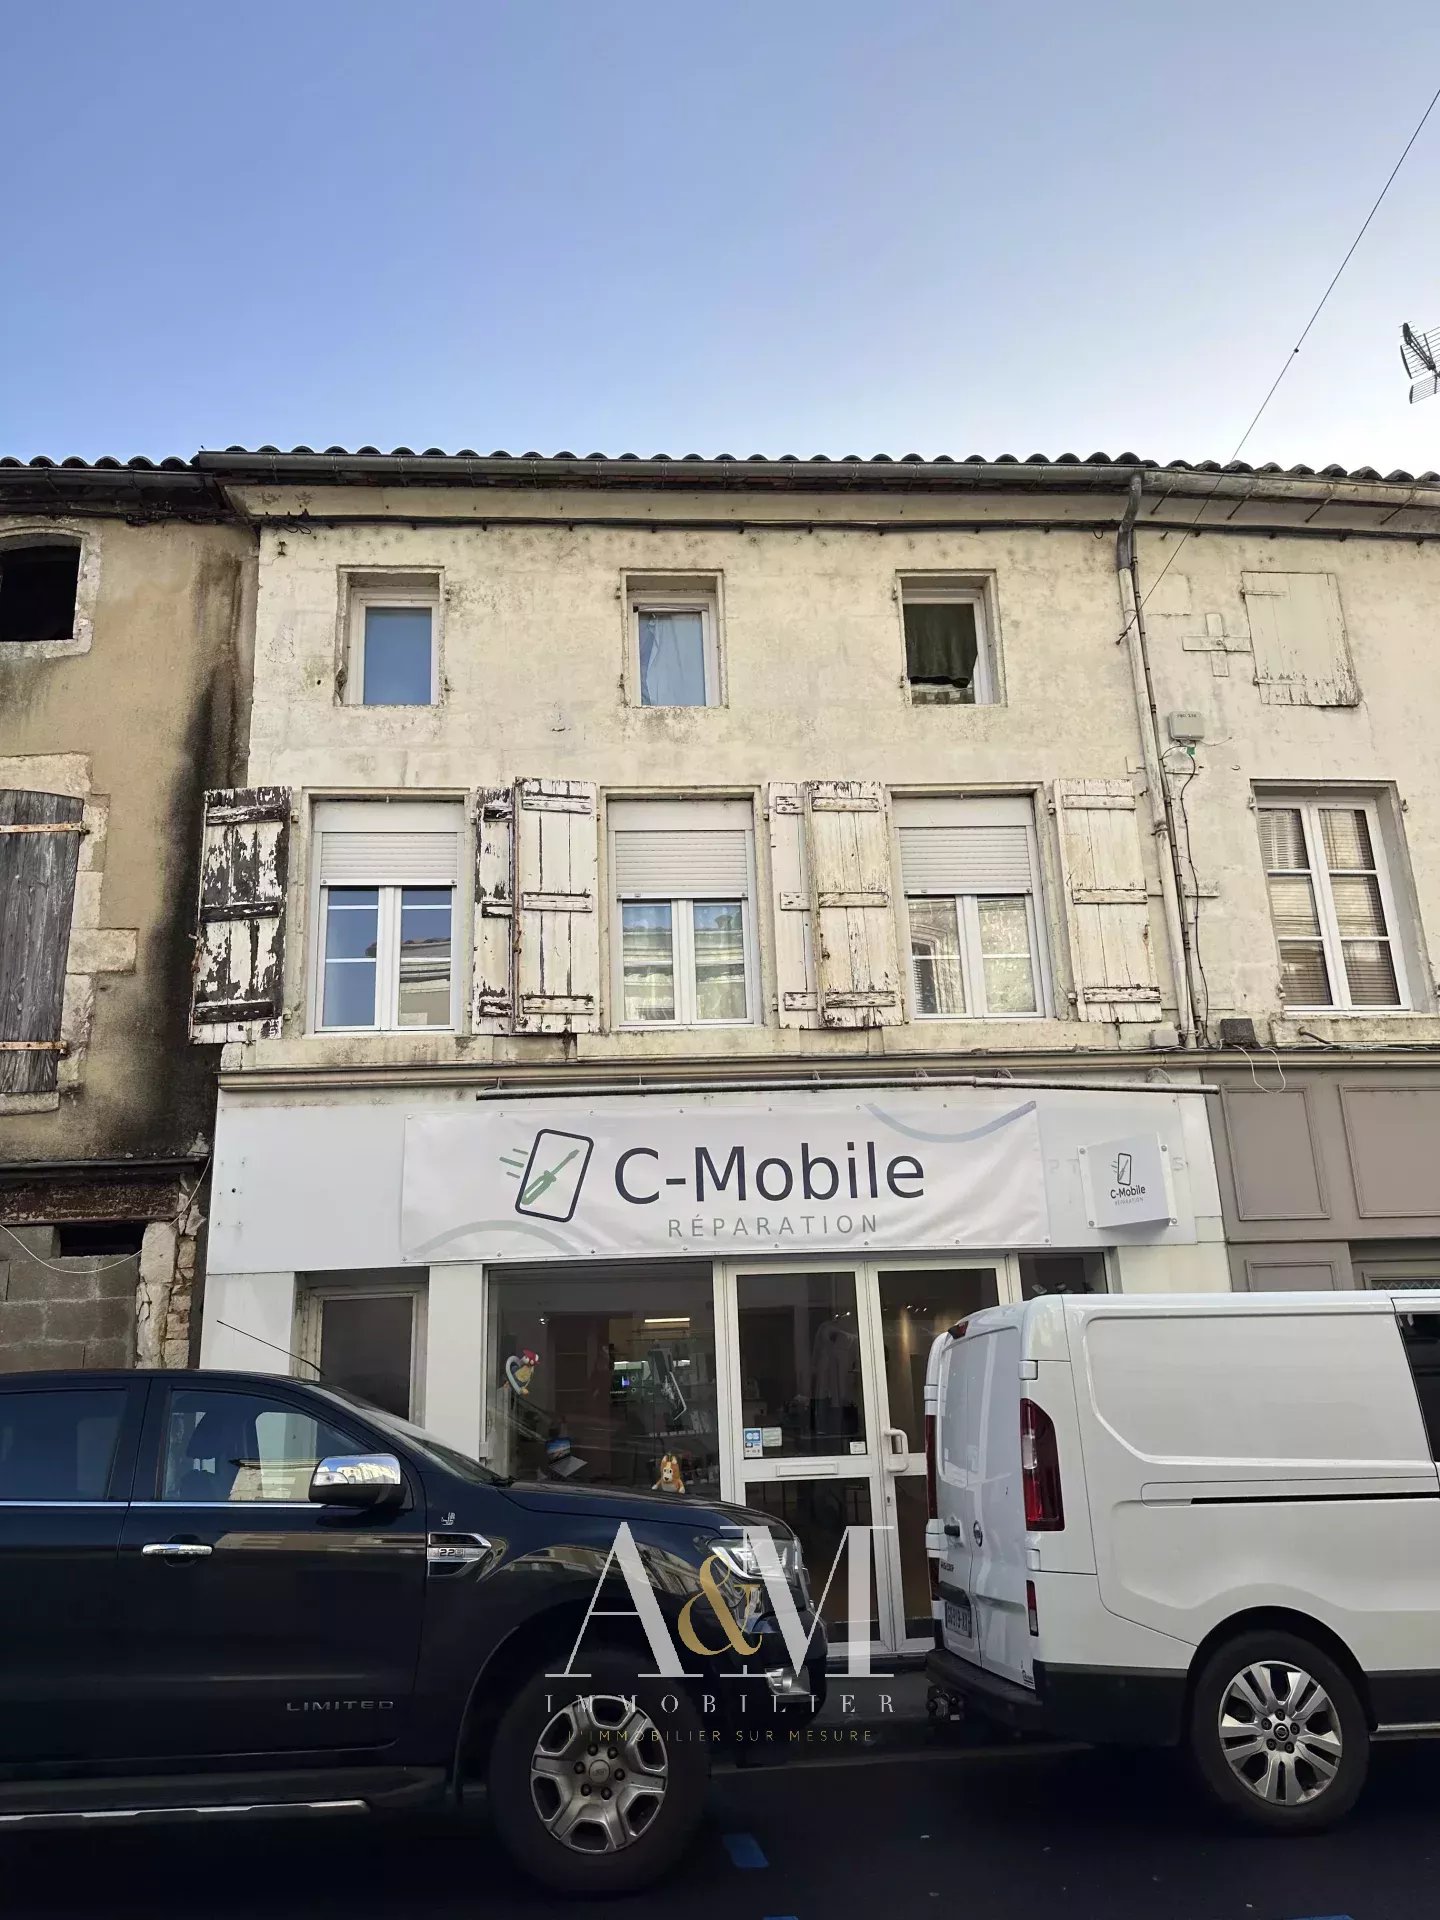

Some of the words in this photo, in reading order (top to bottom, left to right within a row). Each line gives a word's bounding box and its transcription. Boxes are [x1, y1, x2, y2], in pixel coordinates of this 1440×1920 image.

[614, 1141, 925, 1204] C-Mobile
[1110, 1184, 1146, 1199] C-Mobile
[667, 1214, 878, 1238] RÉPARATION
[286, 1701, 394, 1711] LIMITED
